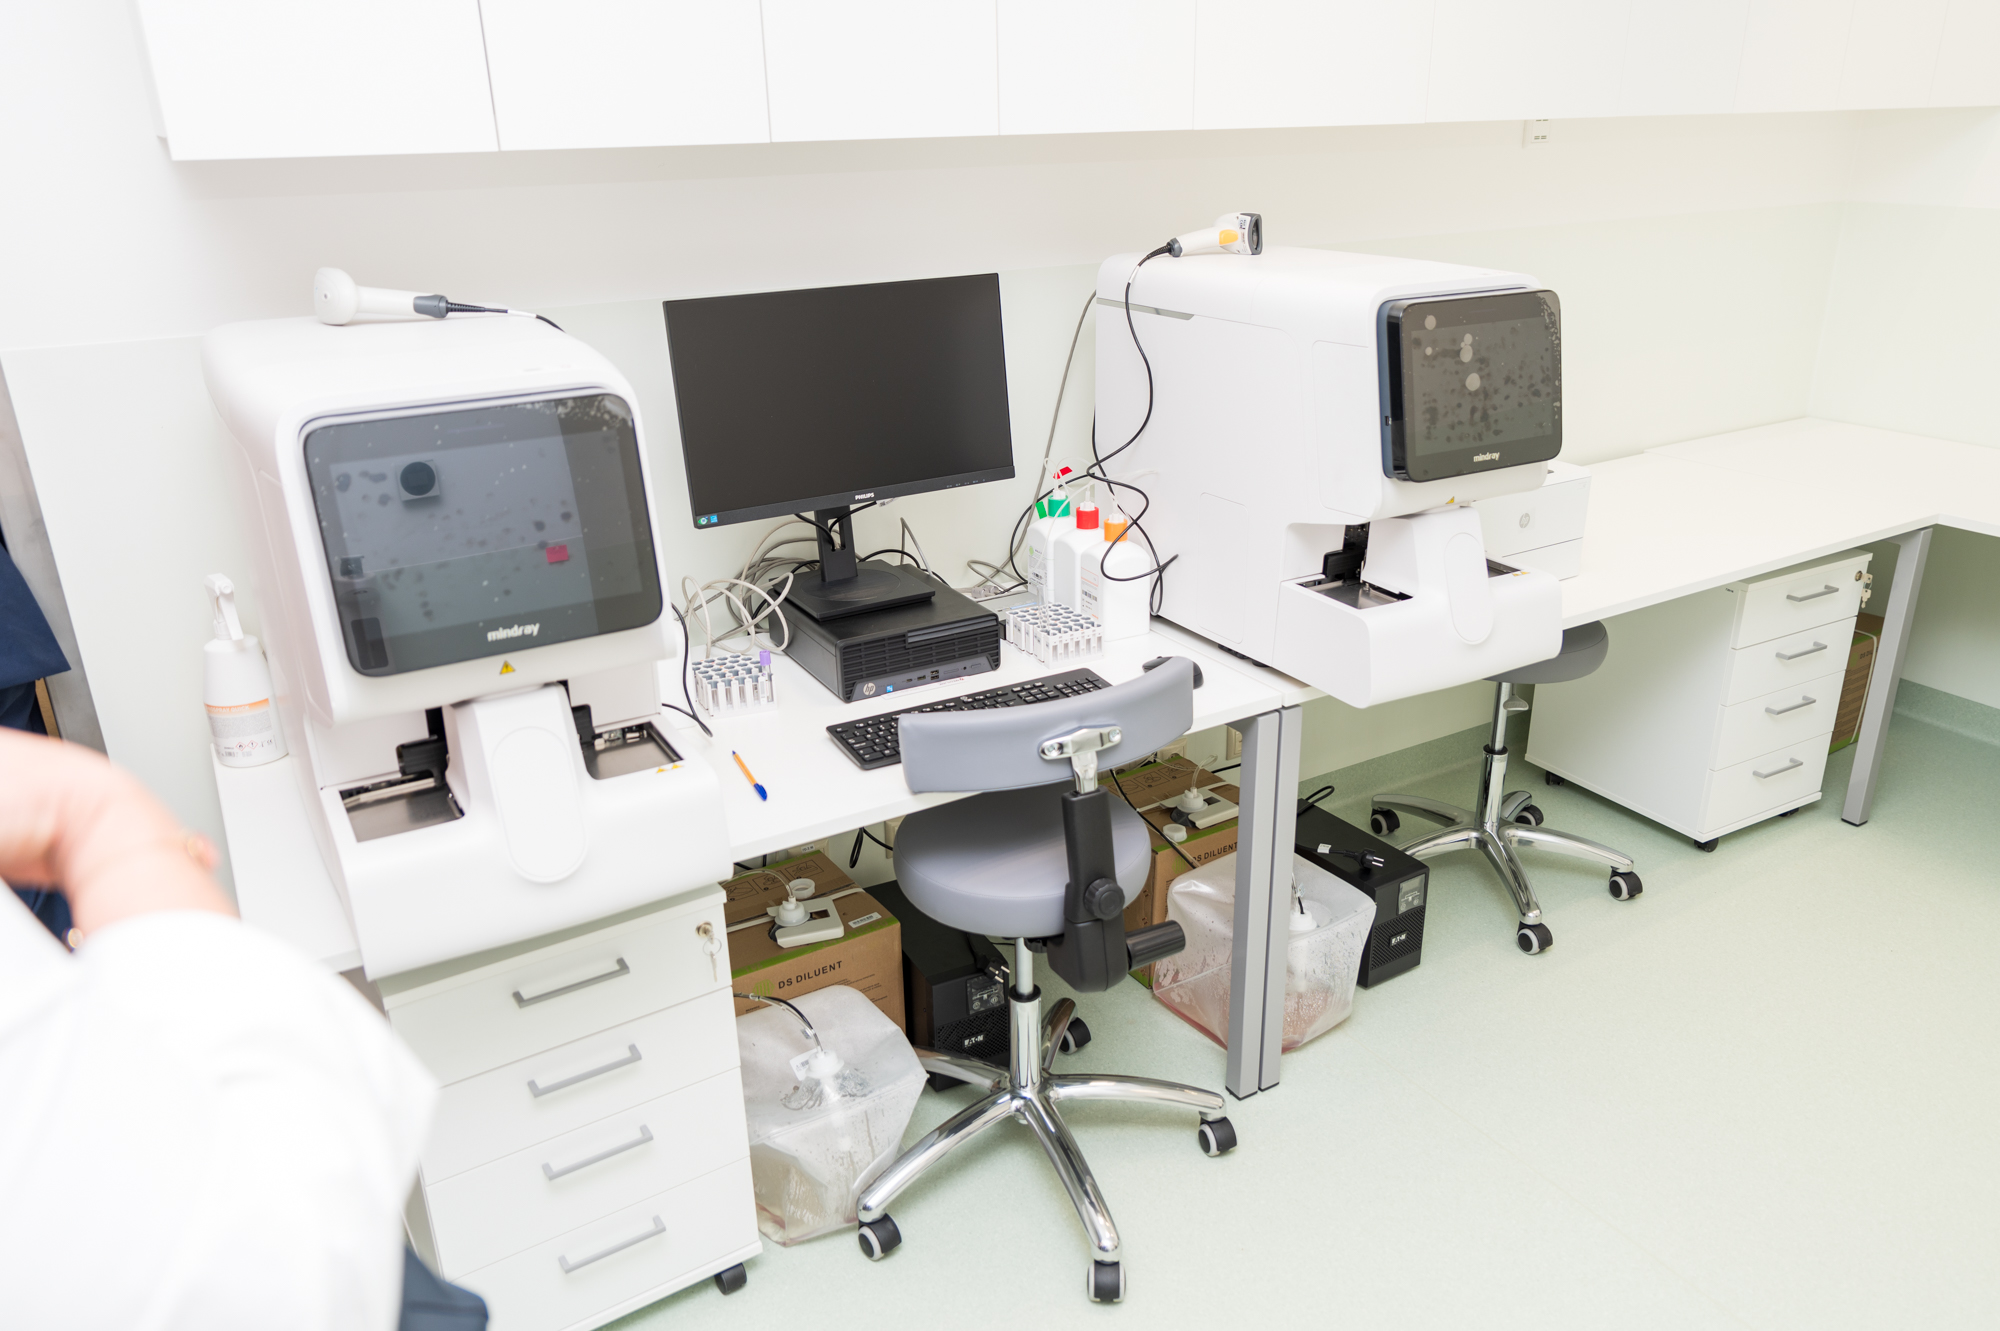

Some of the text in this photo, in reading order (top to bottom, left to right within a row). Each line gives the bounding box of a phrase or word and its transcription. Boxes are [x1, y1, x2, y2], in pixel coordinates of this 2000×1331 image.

[1473, 452, 1500, 462] mindray
[855, 492, 875, 500] PHILIPS
[487, 623, 540, 642] mindray
[863, 683, 876, 695] hp
[778, 977, 793, 989] DS
[796, 960, 843, 984] DILUENT
